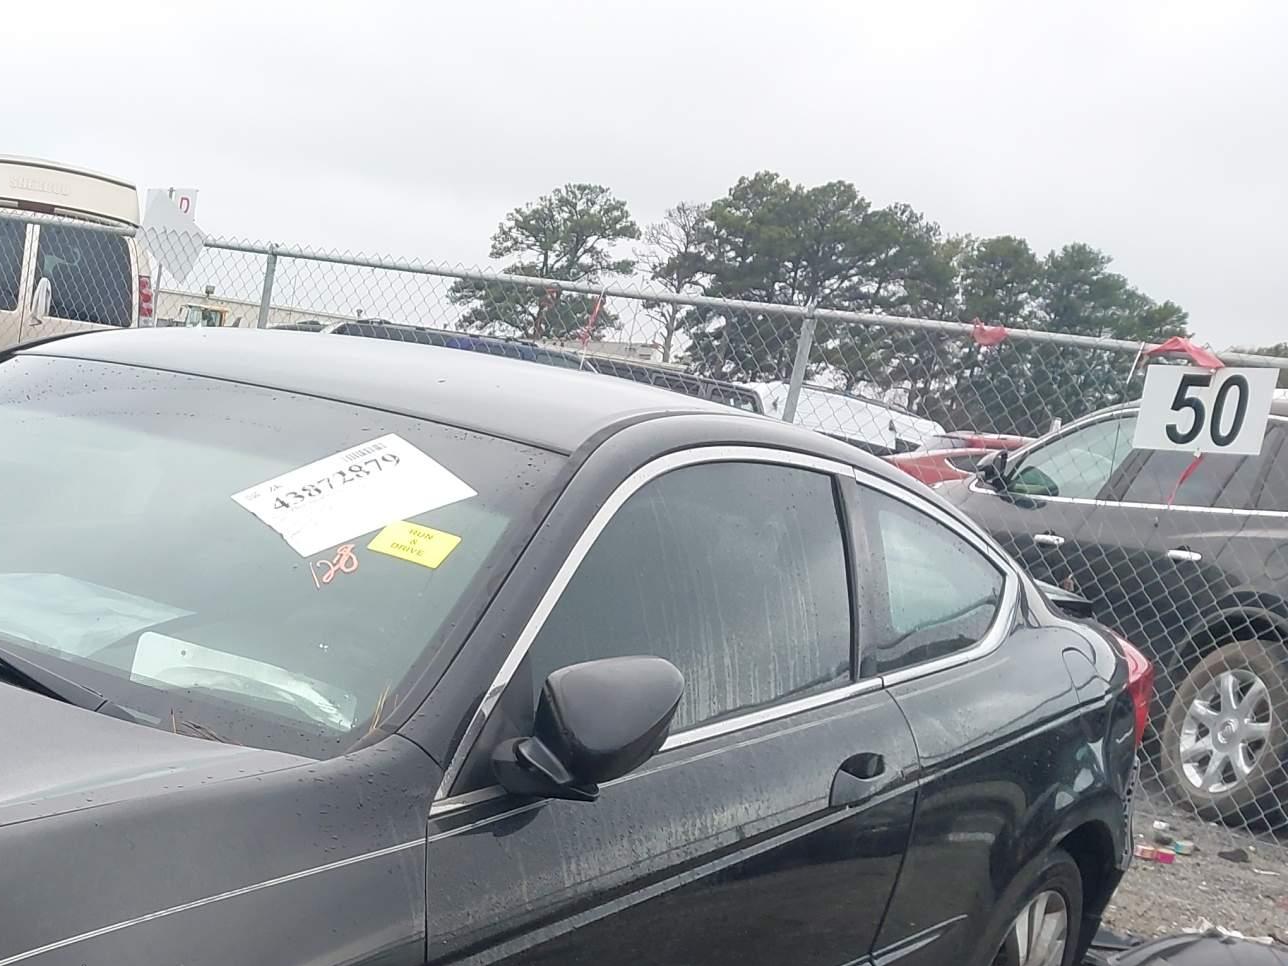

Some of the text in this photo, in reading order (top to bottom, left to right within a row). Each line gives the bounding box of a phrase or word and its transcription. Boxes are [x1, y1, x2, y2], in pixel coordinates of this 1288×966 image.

[1165, 374, 1249, 447] 50
[274, 453, 400, 511] 43872879
[390, 541, 425, 557] DRIVE
[408, 528, 434, 541] RUN
